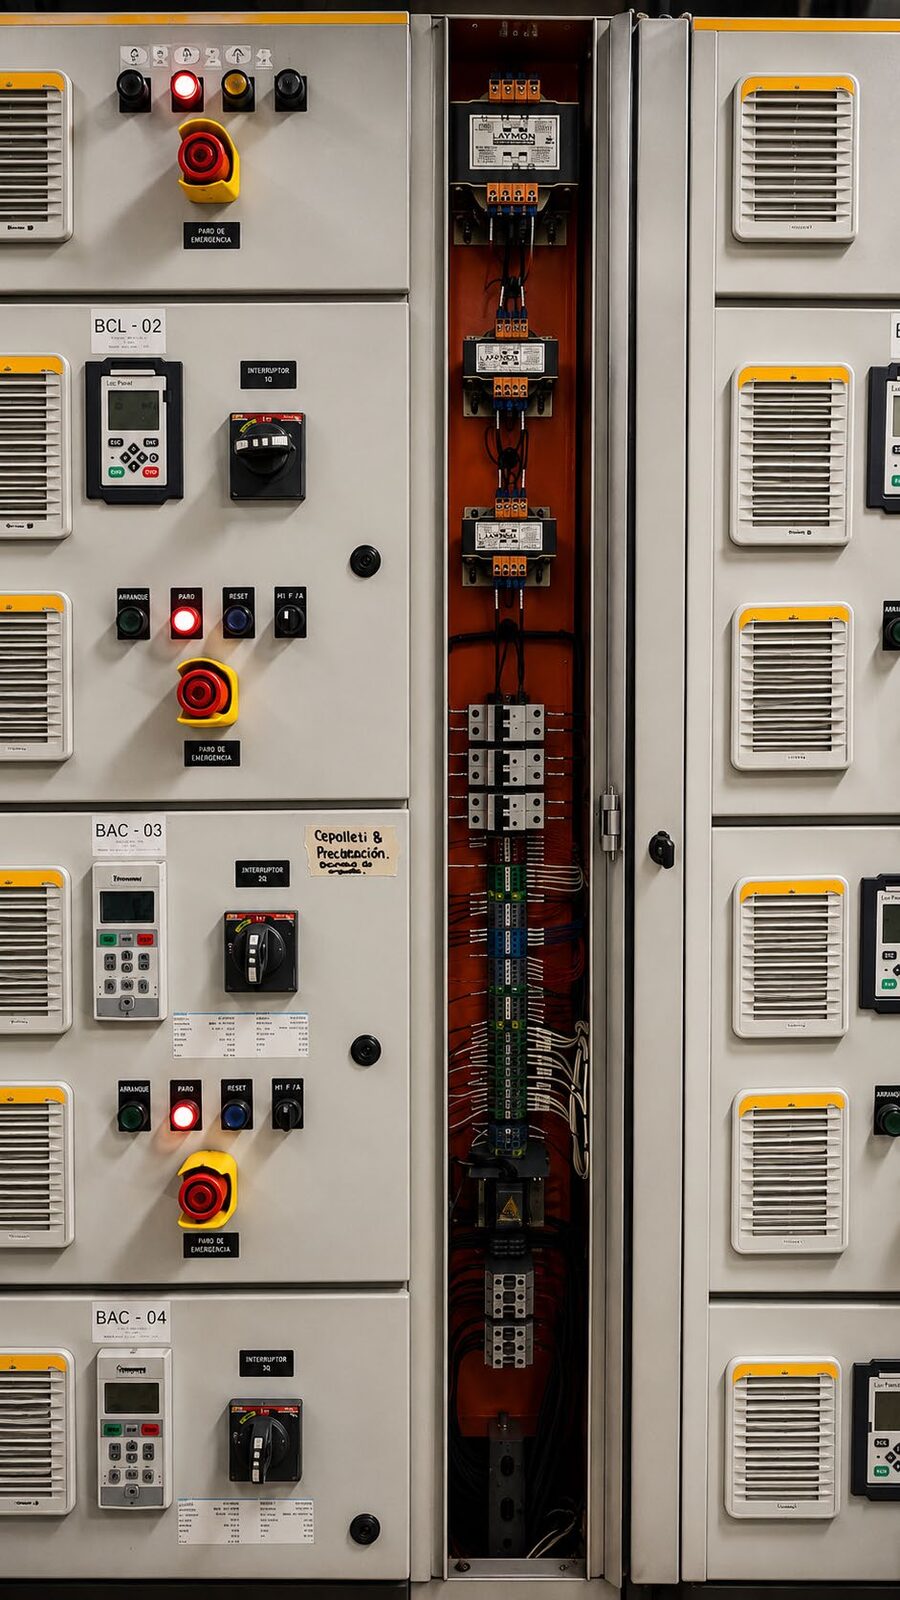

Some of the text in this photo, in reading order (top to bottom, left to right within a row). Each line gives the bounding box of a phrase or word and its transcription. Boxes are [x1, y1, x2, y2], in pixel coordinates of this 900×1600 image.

[95, 319, 126, 333] BCL
[142, 319, 162, 333] 02
[96, 824, 128, 837] BAC
[144, 824, 162, 837] 03
[315, 830, 382, 844] Cepolleti &
[96, 1310, 130, 1324] BAC
[147, 1310, 167, 1324] 04
